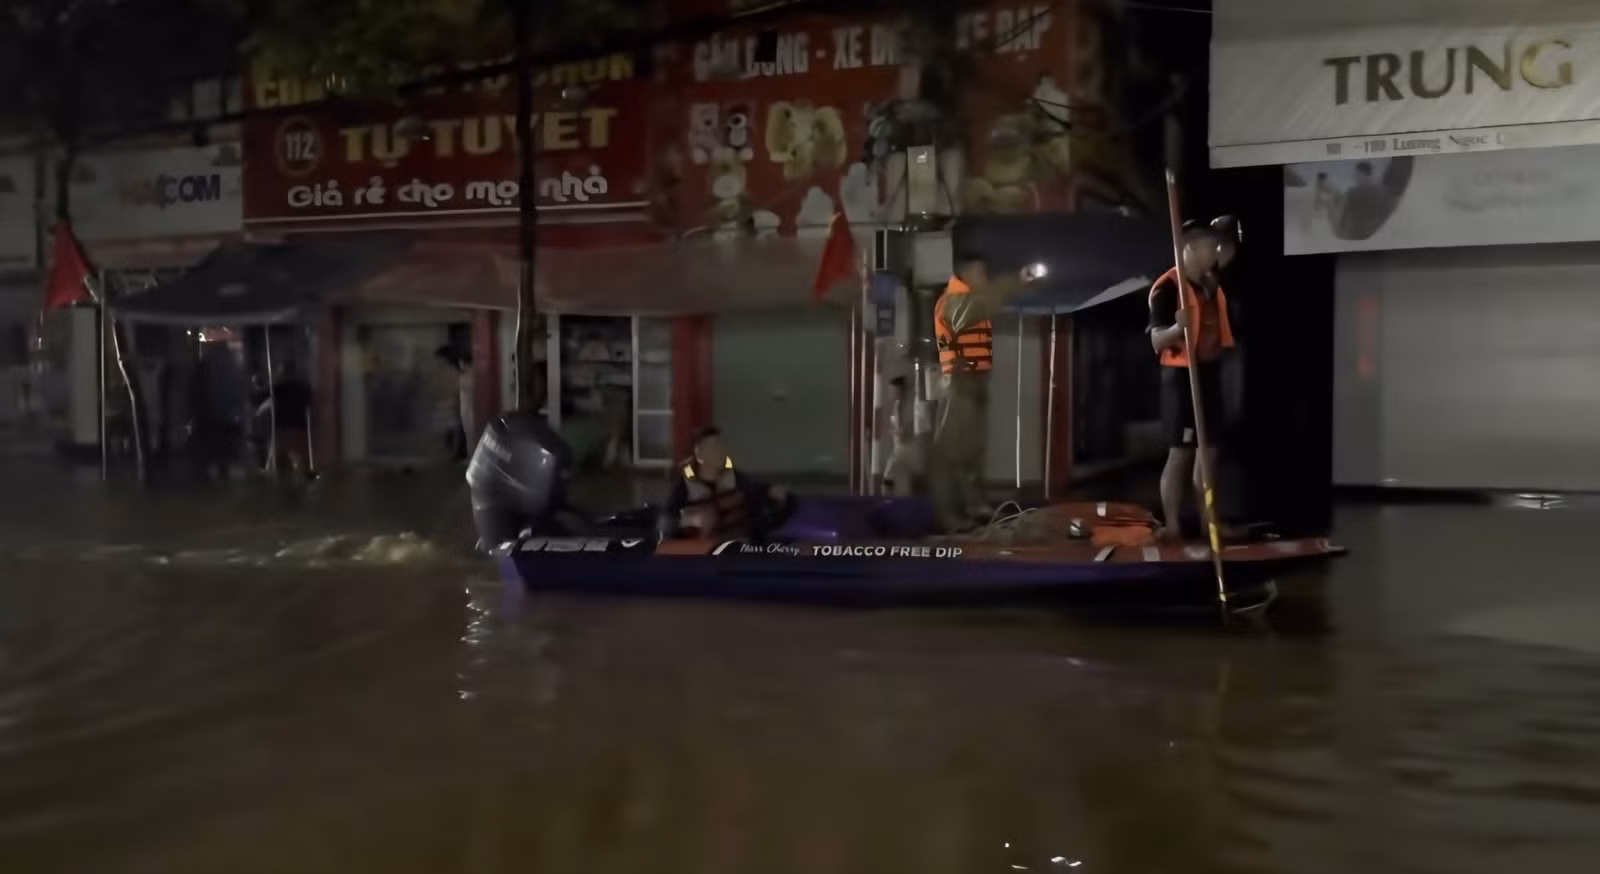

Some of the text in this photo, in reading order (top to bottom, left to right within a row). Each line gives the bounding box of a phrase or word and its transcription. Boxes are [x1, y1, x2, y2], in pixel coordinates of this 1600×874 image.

[1323, 39, 1574, 106] TRUNG
[285, 131, 316, 162] 112
[465, 179, 520, 206] mọ
[812, 545, 963, 558] TOBACCO FREE DIP
